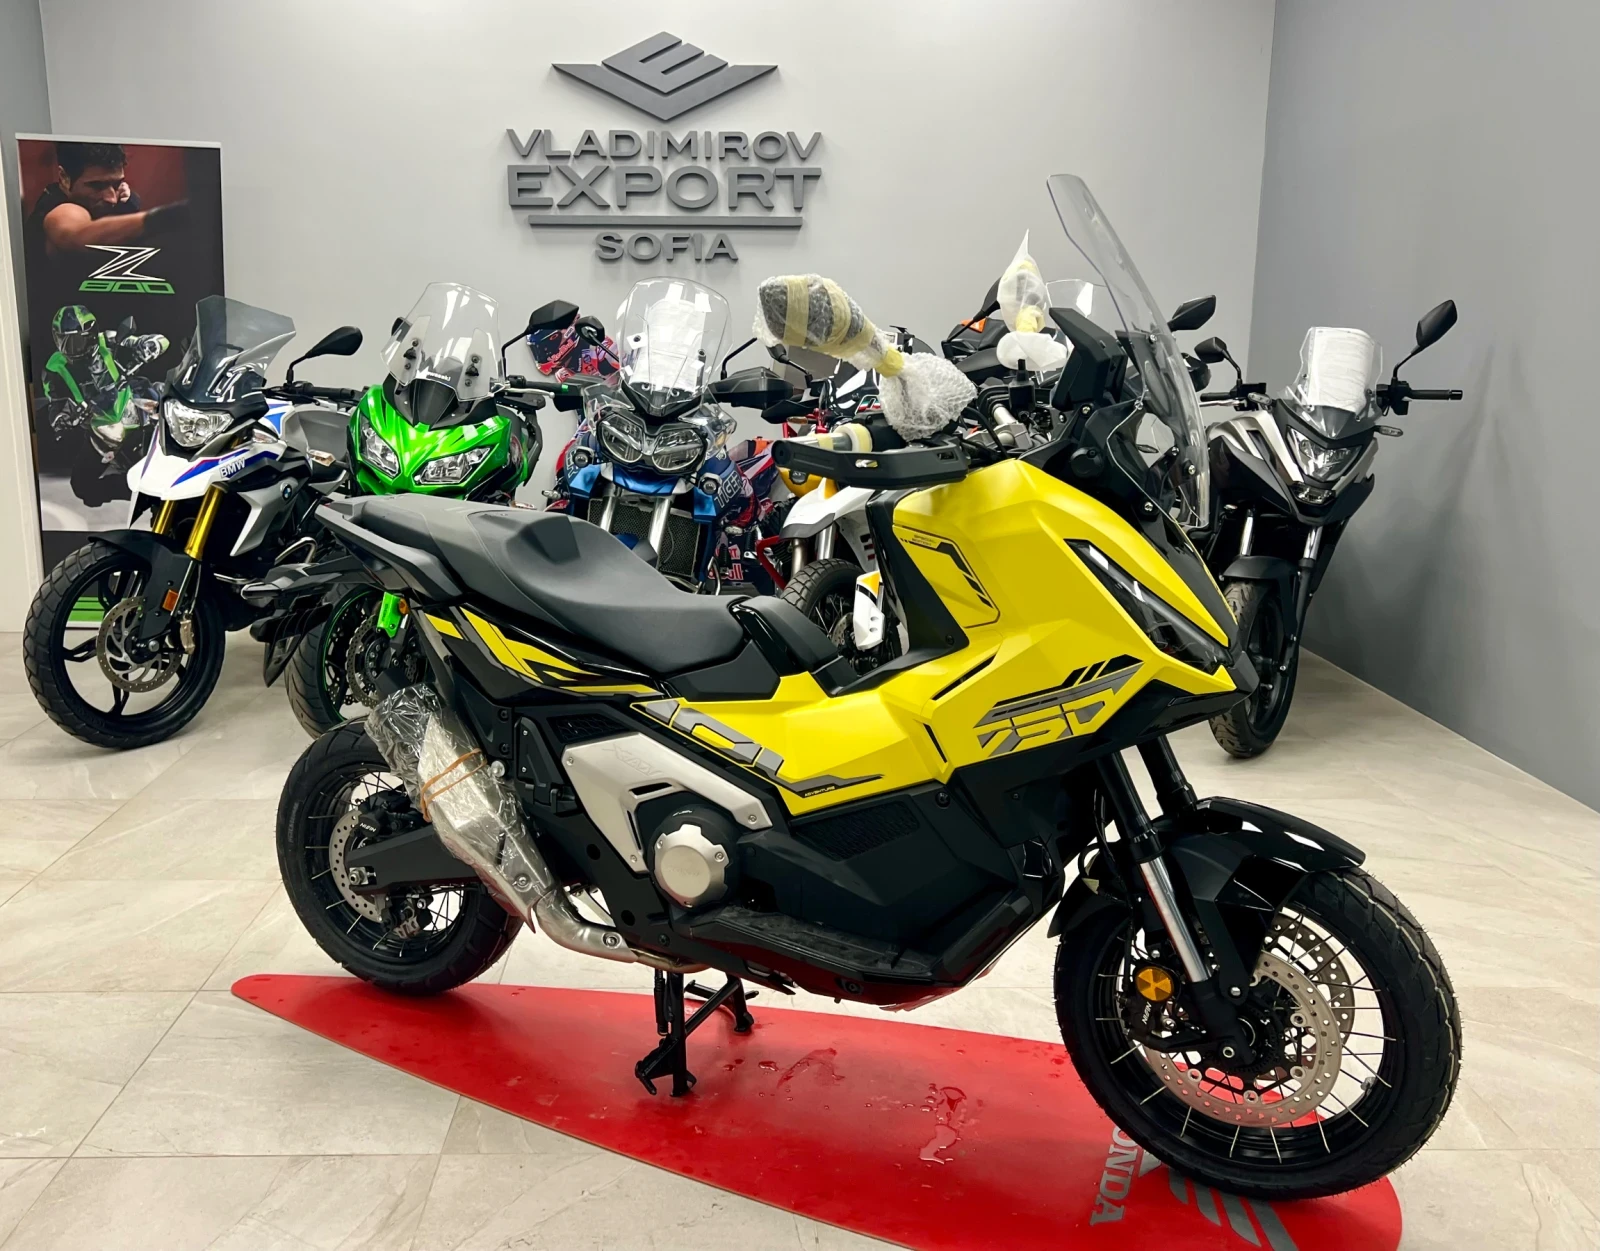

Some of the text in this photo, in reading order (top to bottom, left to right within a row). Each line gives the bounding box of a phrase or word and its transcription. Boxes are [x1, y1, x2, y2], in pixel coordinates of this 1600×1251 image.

[506, 128, 822, 160] VLADIMIROV
[507, 164, 822, 210] EXPORT
[595, 232, 738, 261] SOFIA
[78, 280, 175, 294] 800
[220, 457, 246, 478] BMW
[1089, 1125, 1138, 1227] ONDA
